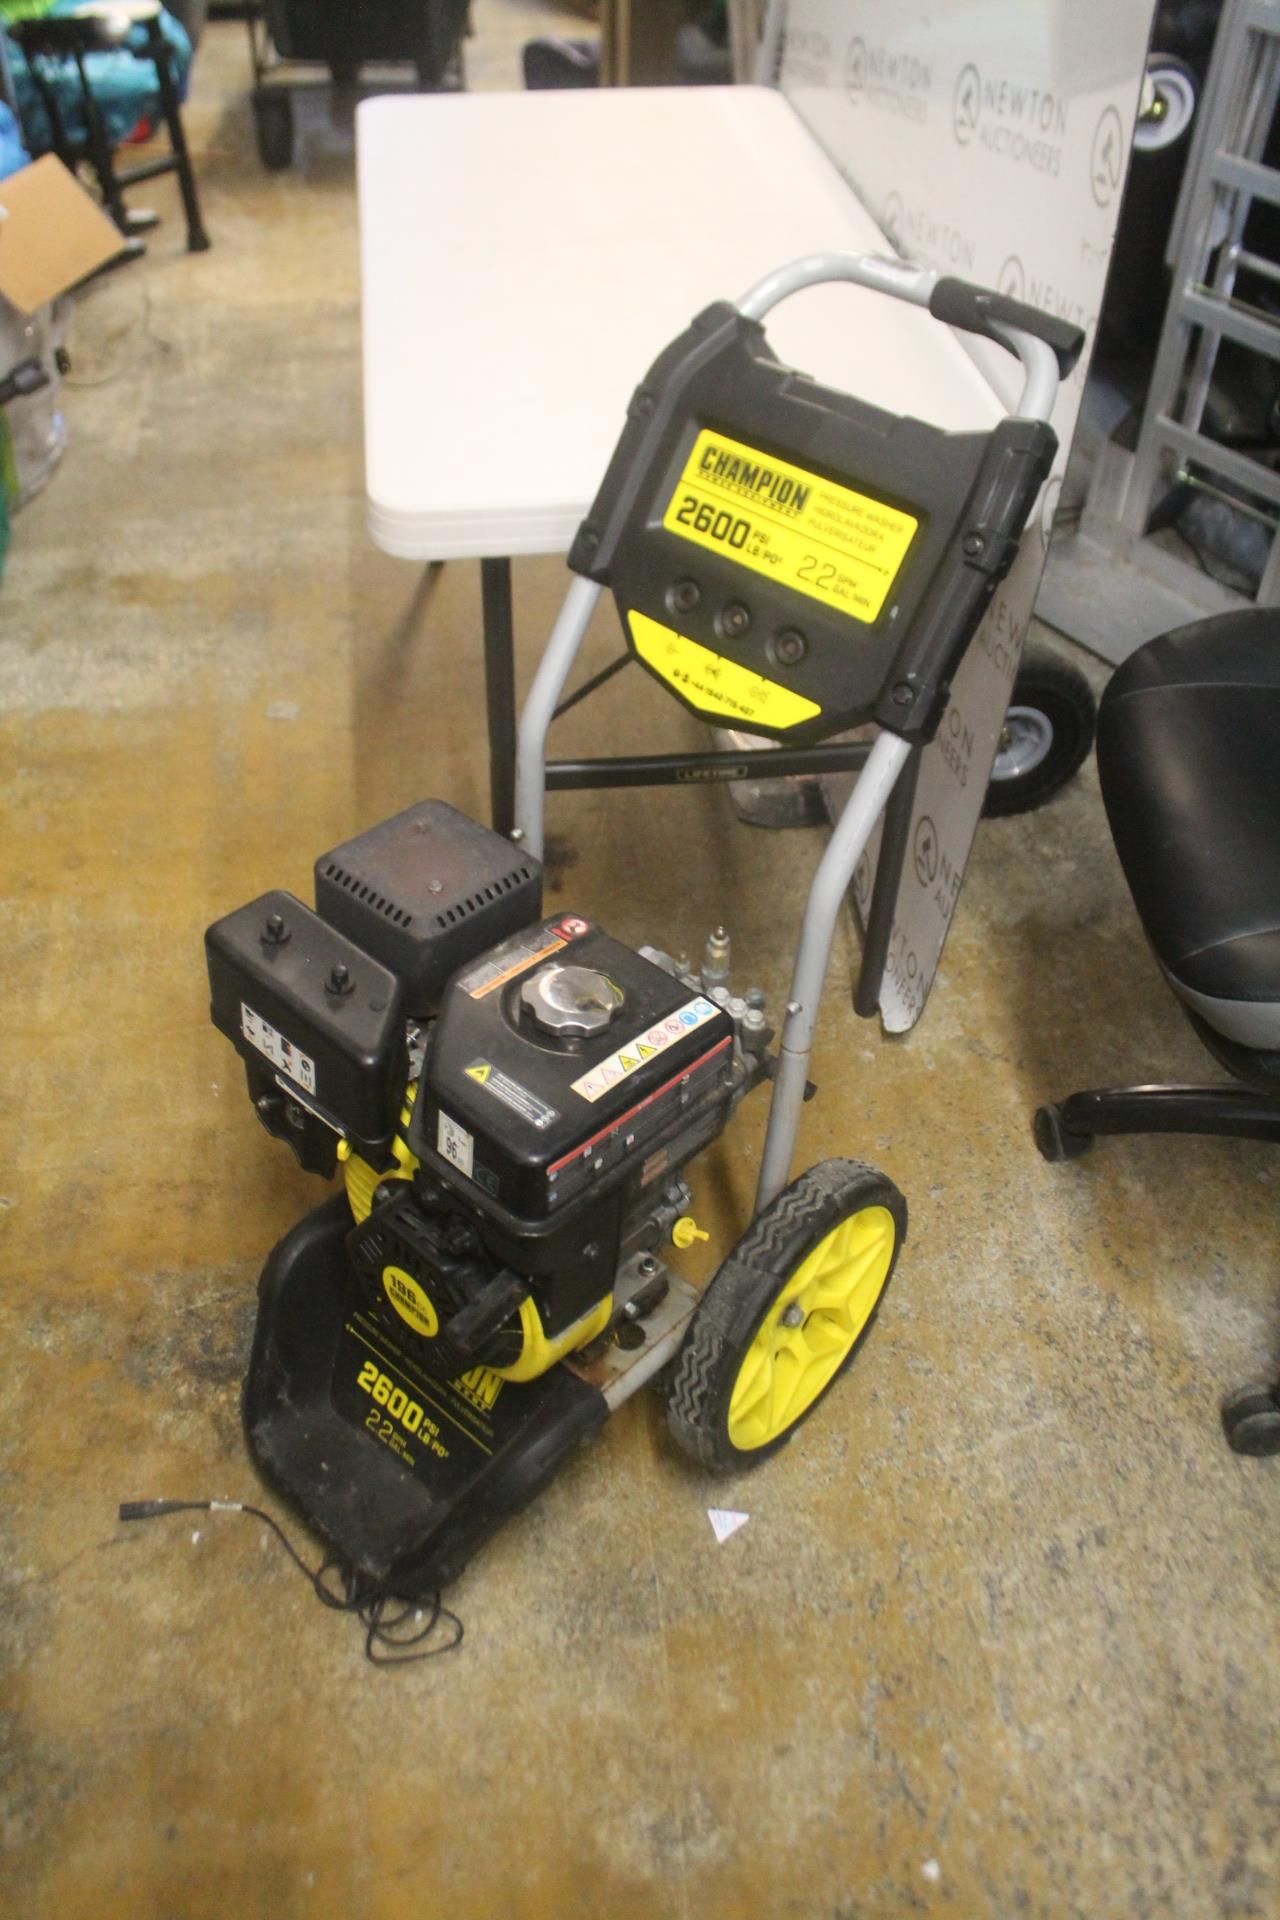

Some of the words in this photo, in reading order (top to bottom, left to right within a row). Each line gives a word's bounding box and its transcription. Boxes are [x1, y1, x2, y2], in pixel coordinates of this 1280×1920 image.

[866, 46, 932, 89] NEWTON
[984, 77, 1069, 135] NEWTON
[906, 207, 975, 273] NEWTON
[699, 445, 811, 512] CHAMPION
[676, 496, 750, 549] 2600
[752, 530, 770, 545] PSI
[357, 1360, 424, 1433] 2600
[423, 1418, 440, 1437] PSI
